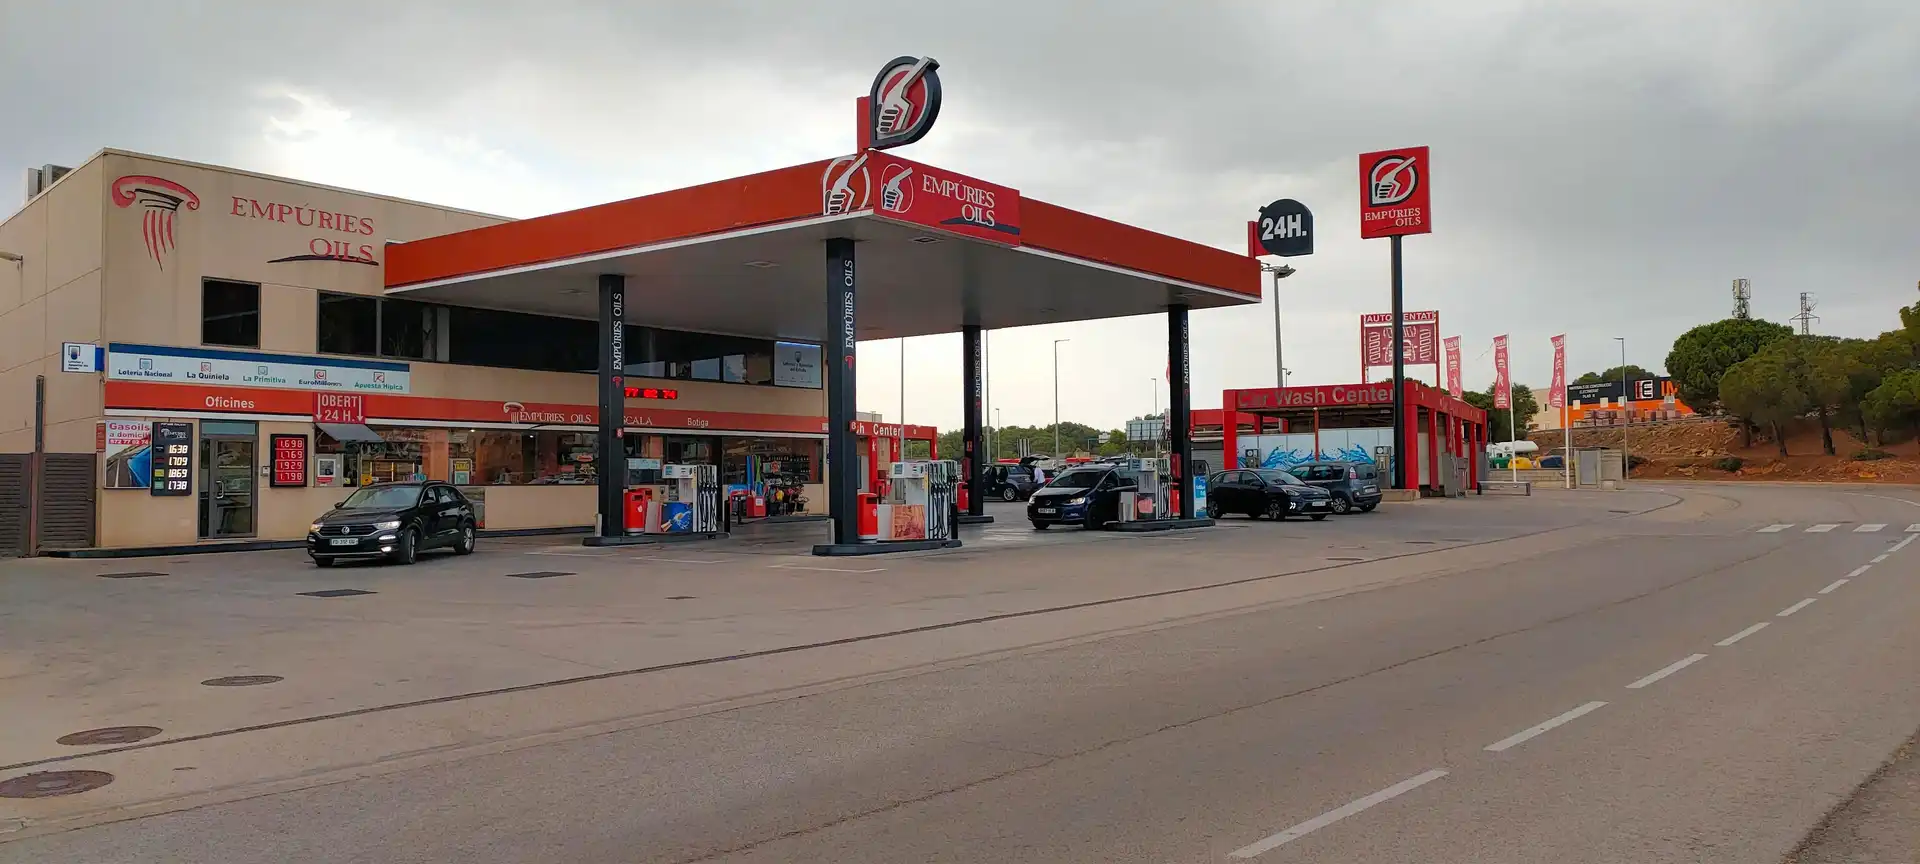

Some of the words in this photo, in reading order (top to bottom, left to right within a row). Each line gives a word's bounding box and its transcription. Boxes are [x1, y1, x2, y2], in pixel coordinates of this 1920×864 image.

[922, 173, 995, 208] EMPÚRIES
[230, 196, 374, 236] EMPÚRIES
[961, 203, 996, 227] OILS
[1364, 207, 1421, 222] EMPÚRIES
[1261, 213, 1307, 241] 24H.
[1395, 217, 1421, 227] OILS
[309, 237, 373, 262] OILS
[844, 260, 853, 287] OILS
[613, 293, 622, 317] OILS
[843, 291, 854, 349] EMPÚRIES
[1366, 311, 1433, 323] AUTOENTAT
[612, 320, 622, 371] EMPÚRIES
[144, 370, 173, 378] Nacional
[186, 371, 196, 379] La
[198, 372, 230, 381] Quiniela
[254, 376, 286, 384] Primitiva
[354, 381, 381, 390] Apuesta
[205, 395, 255, 409] Oficines
[321, 394, 358, 408] OBERT
[1238, 389, 1269, 408] Car
[1273, 387, 1326, 406] Wash
[1332, 386, 1394, 404] Center
[324, 409, 339, 421] 24
[343, 410, 355, 422] H.
[571, 413, 592, 424] OILS
[687, 417, 709, 428] Botiga
[109, 422, 150, 432] Gasoils
[873, 423, 901, 437] Center
